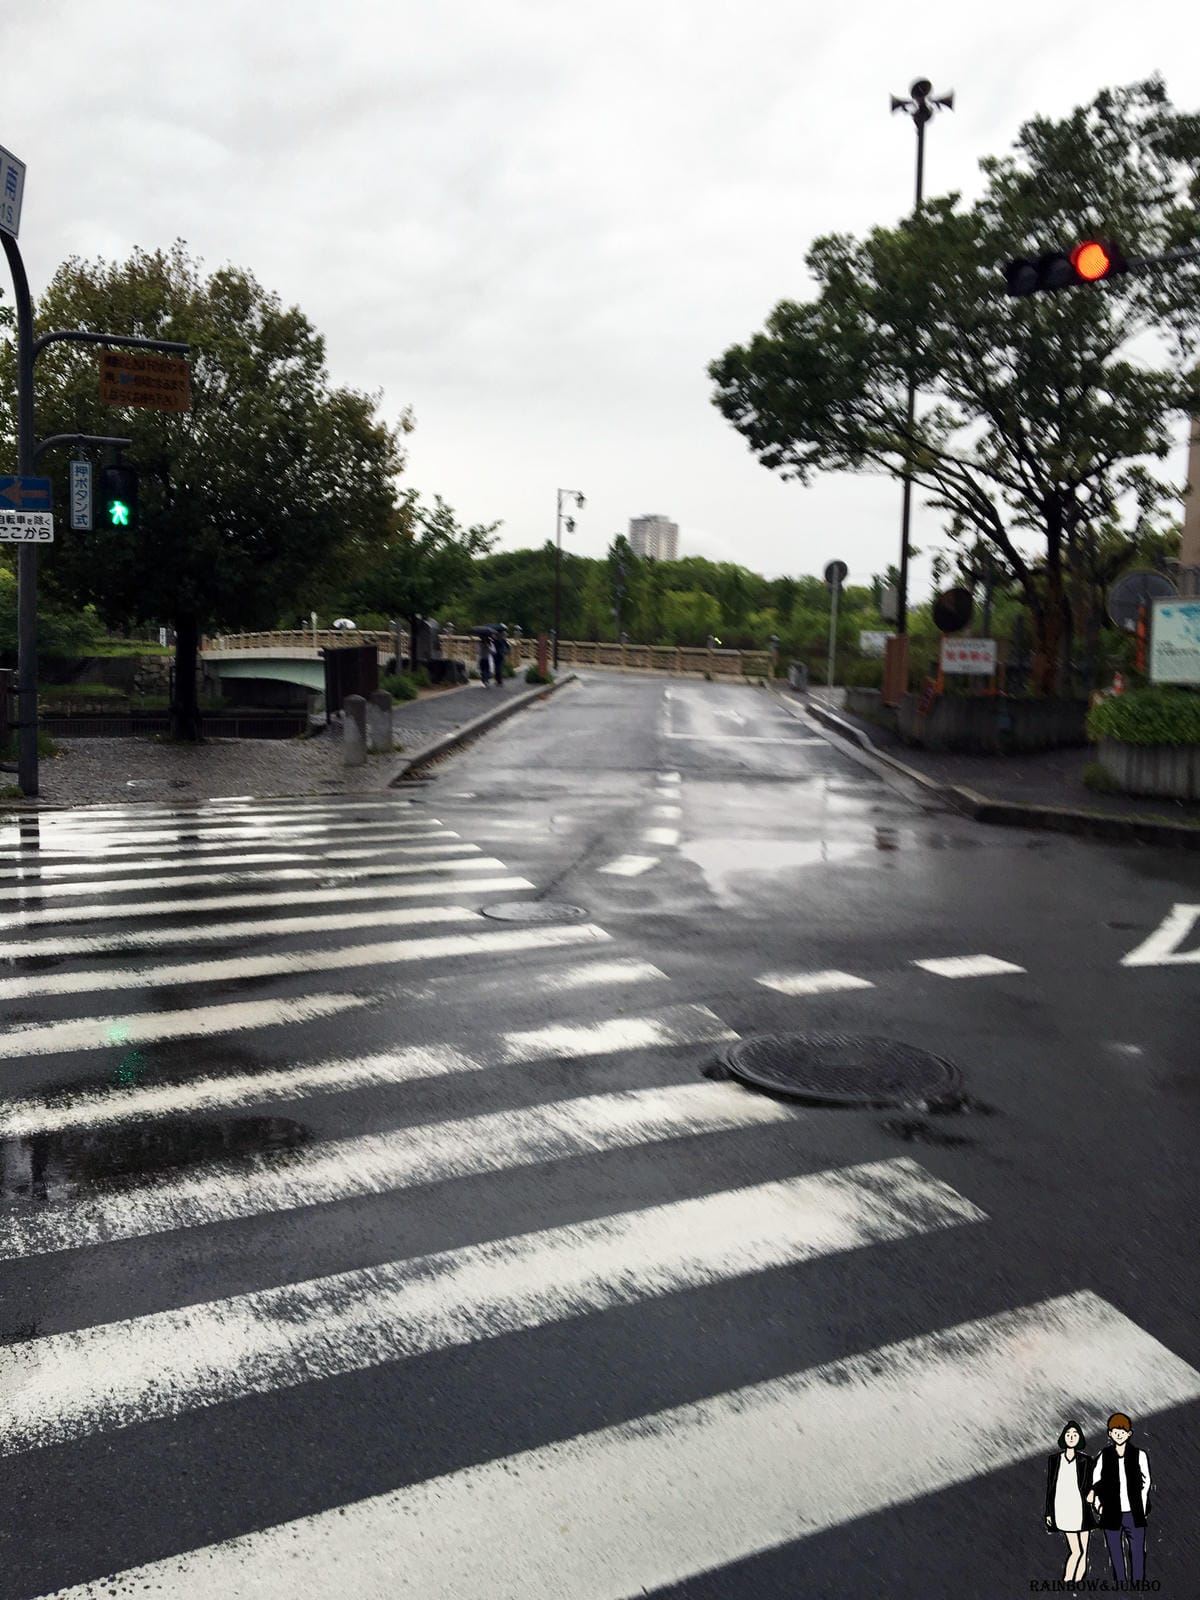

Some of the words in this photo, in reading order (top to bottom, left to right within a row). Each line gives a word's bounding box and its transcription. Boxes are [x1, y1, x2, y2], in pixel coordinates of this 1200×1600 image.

[74, 464, 88, 526] 押ボタン式
[0, 526, 50, 540] ここから
